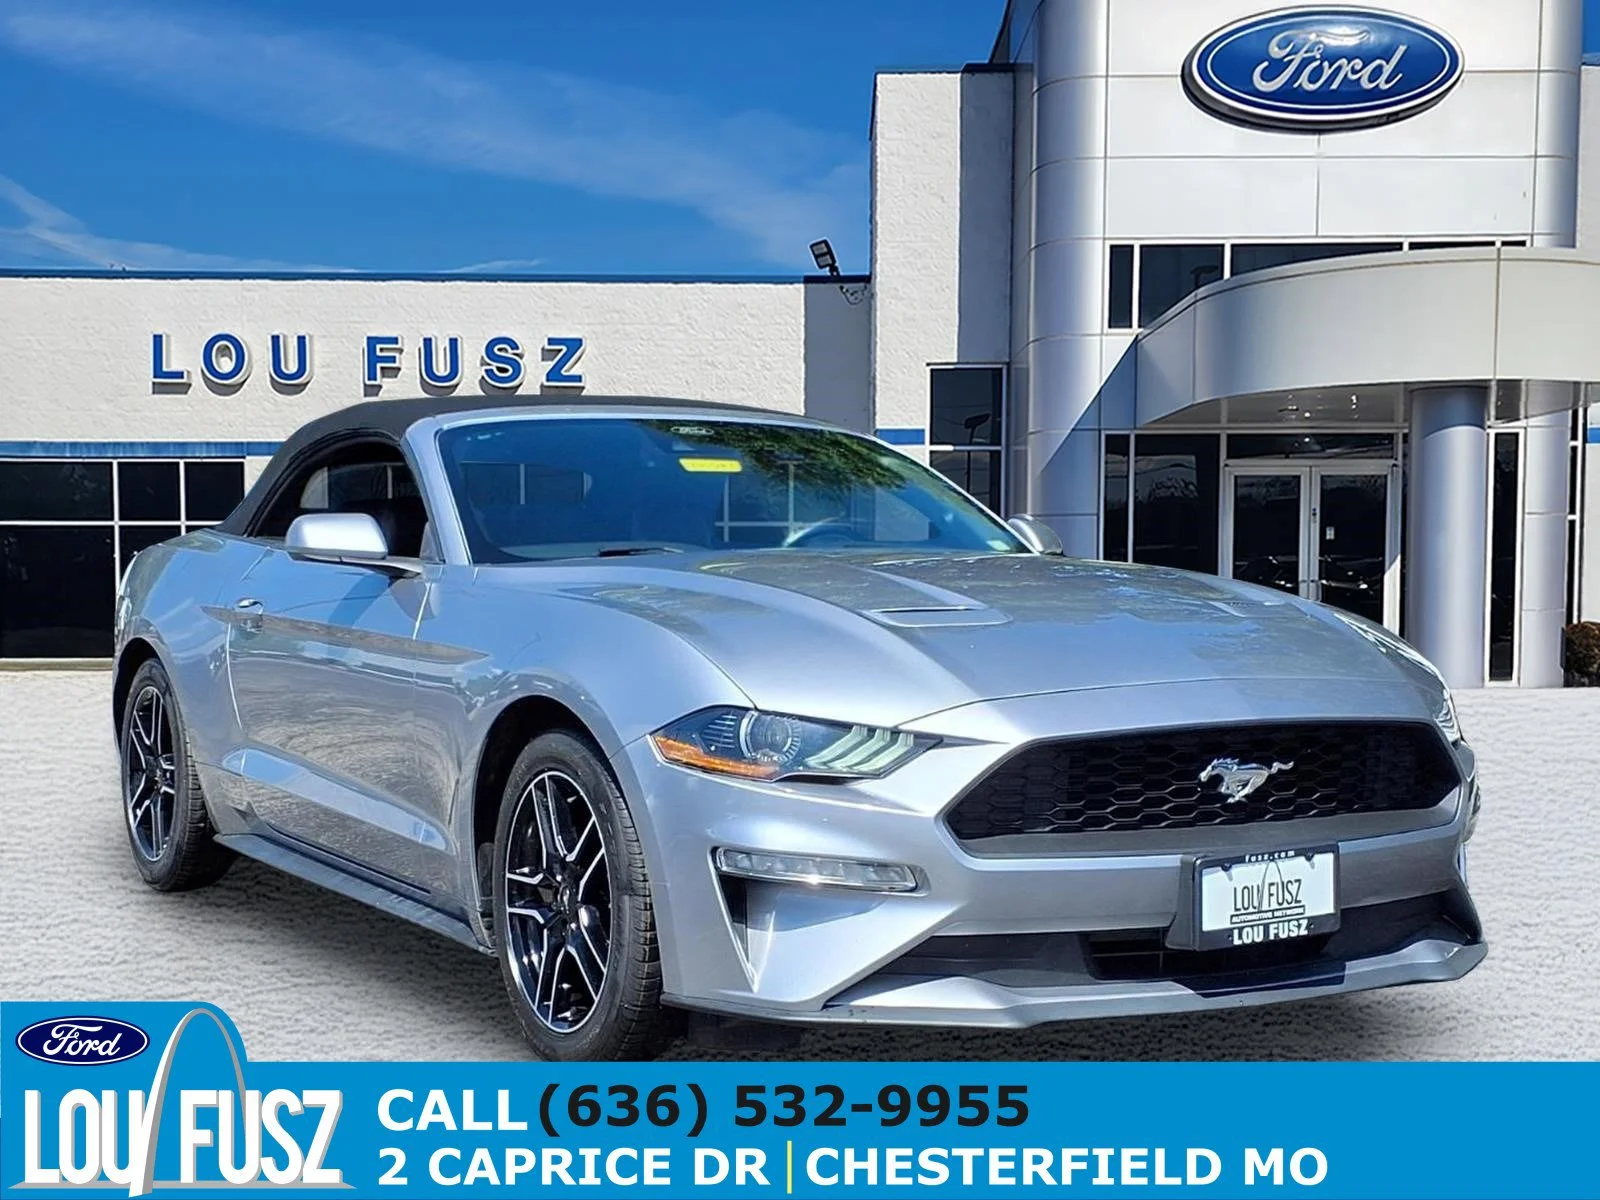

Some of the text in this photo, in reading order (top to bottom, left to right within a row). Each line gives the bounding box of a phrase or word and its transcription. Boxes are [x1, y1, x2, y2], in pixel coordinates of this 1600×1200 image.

[1252, 28, 1408, 92] Ford
[151, 332, 587, 388] LOU FUSZ
[1233, 878, 1303, 912] LOU FUSZ
[1233, 918, 1309, 945] LOU FUSZ
